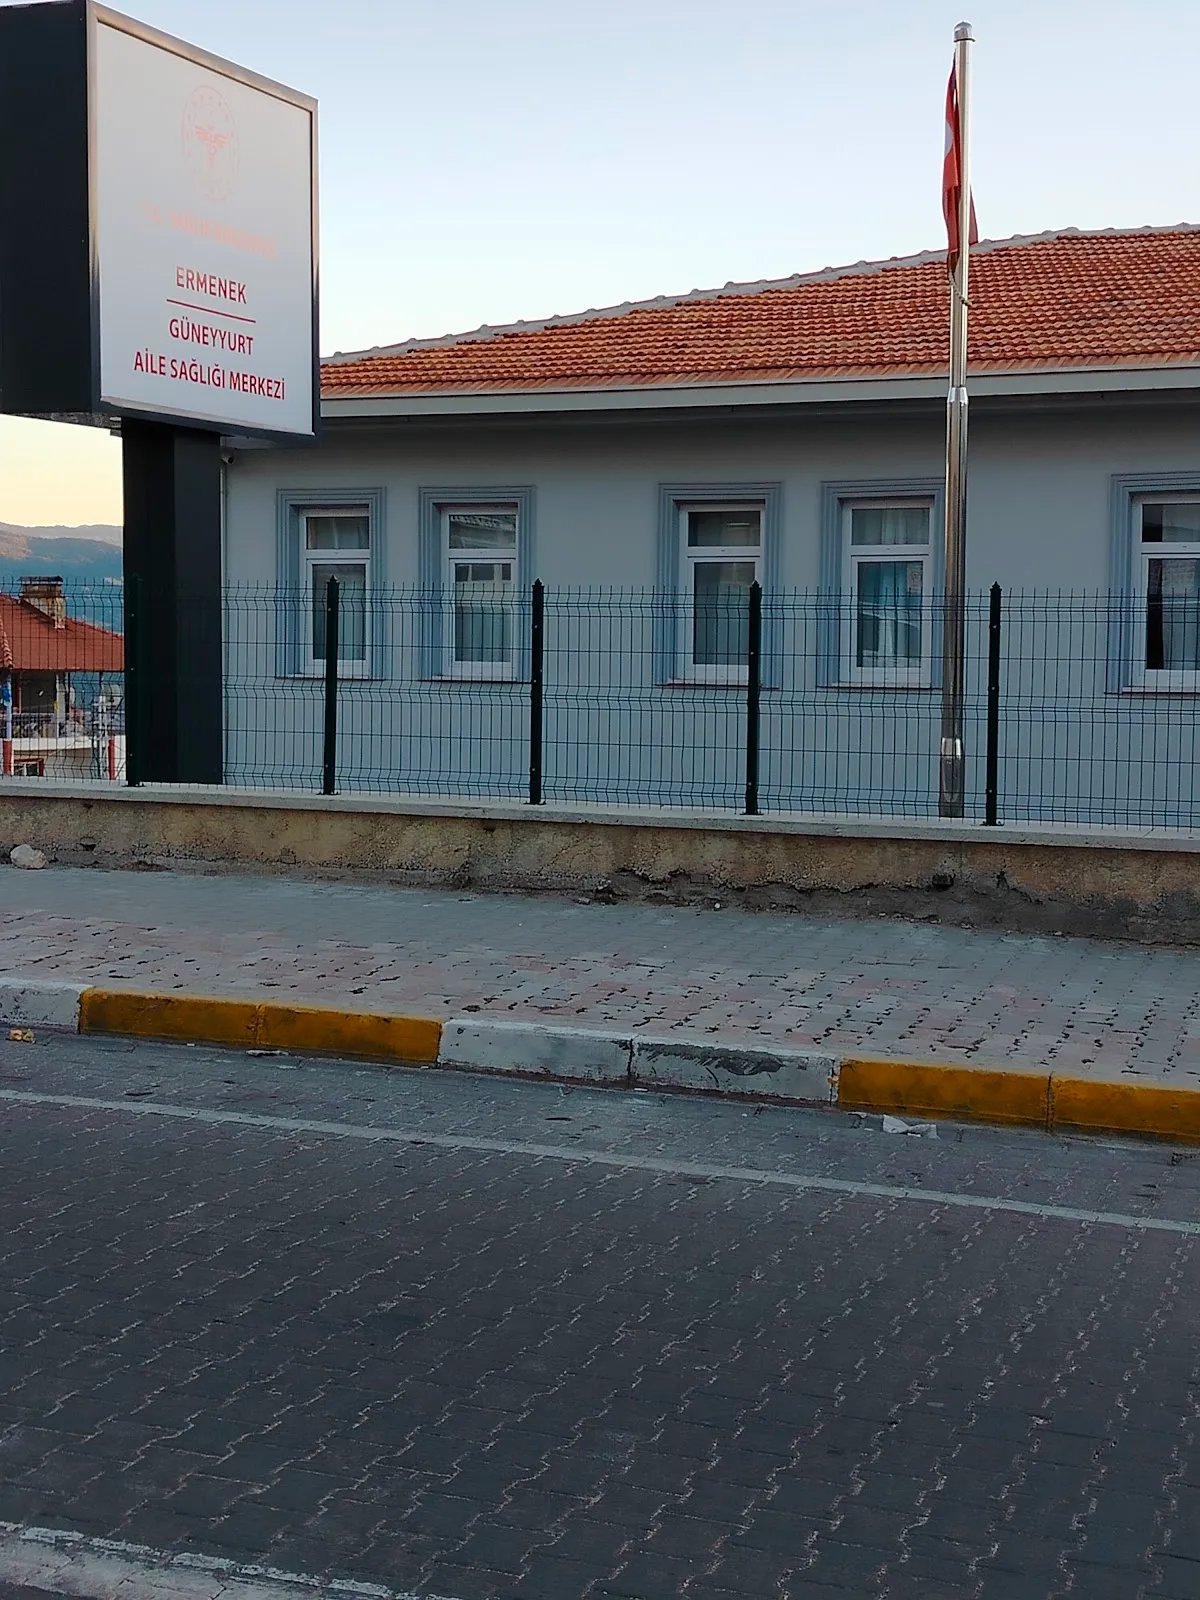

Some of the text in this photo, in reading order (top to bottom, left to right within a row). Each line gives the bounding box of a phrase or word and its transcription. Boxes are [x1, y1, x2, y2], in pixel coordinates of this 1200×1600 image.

[176, 265, 247, 304] ERMENEK
[169, 316, 254, 355] GÜNEYYURT
[134, 348, 285, 400] AİLE SAĞLIĞI MERKEZİ
